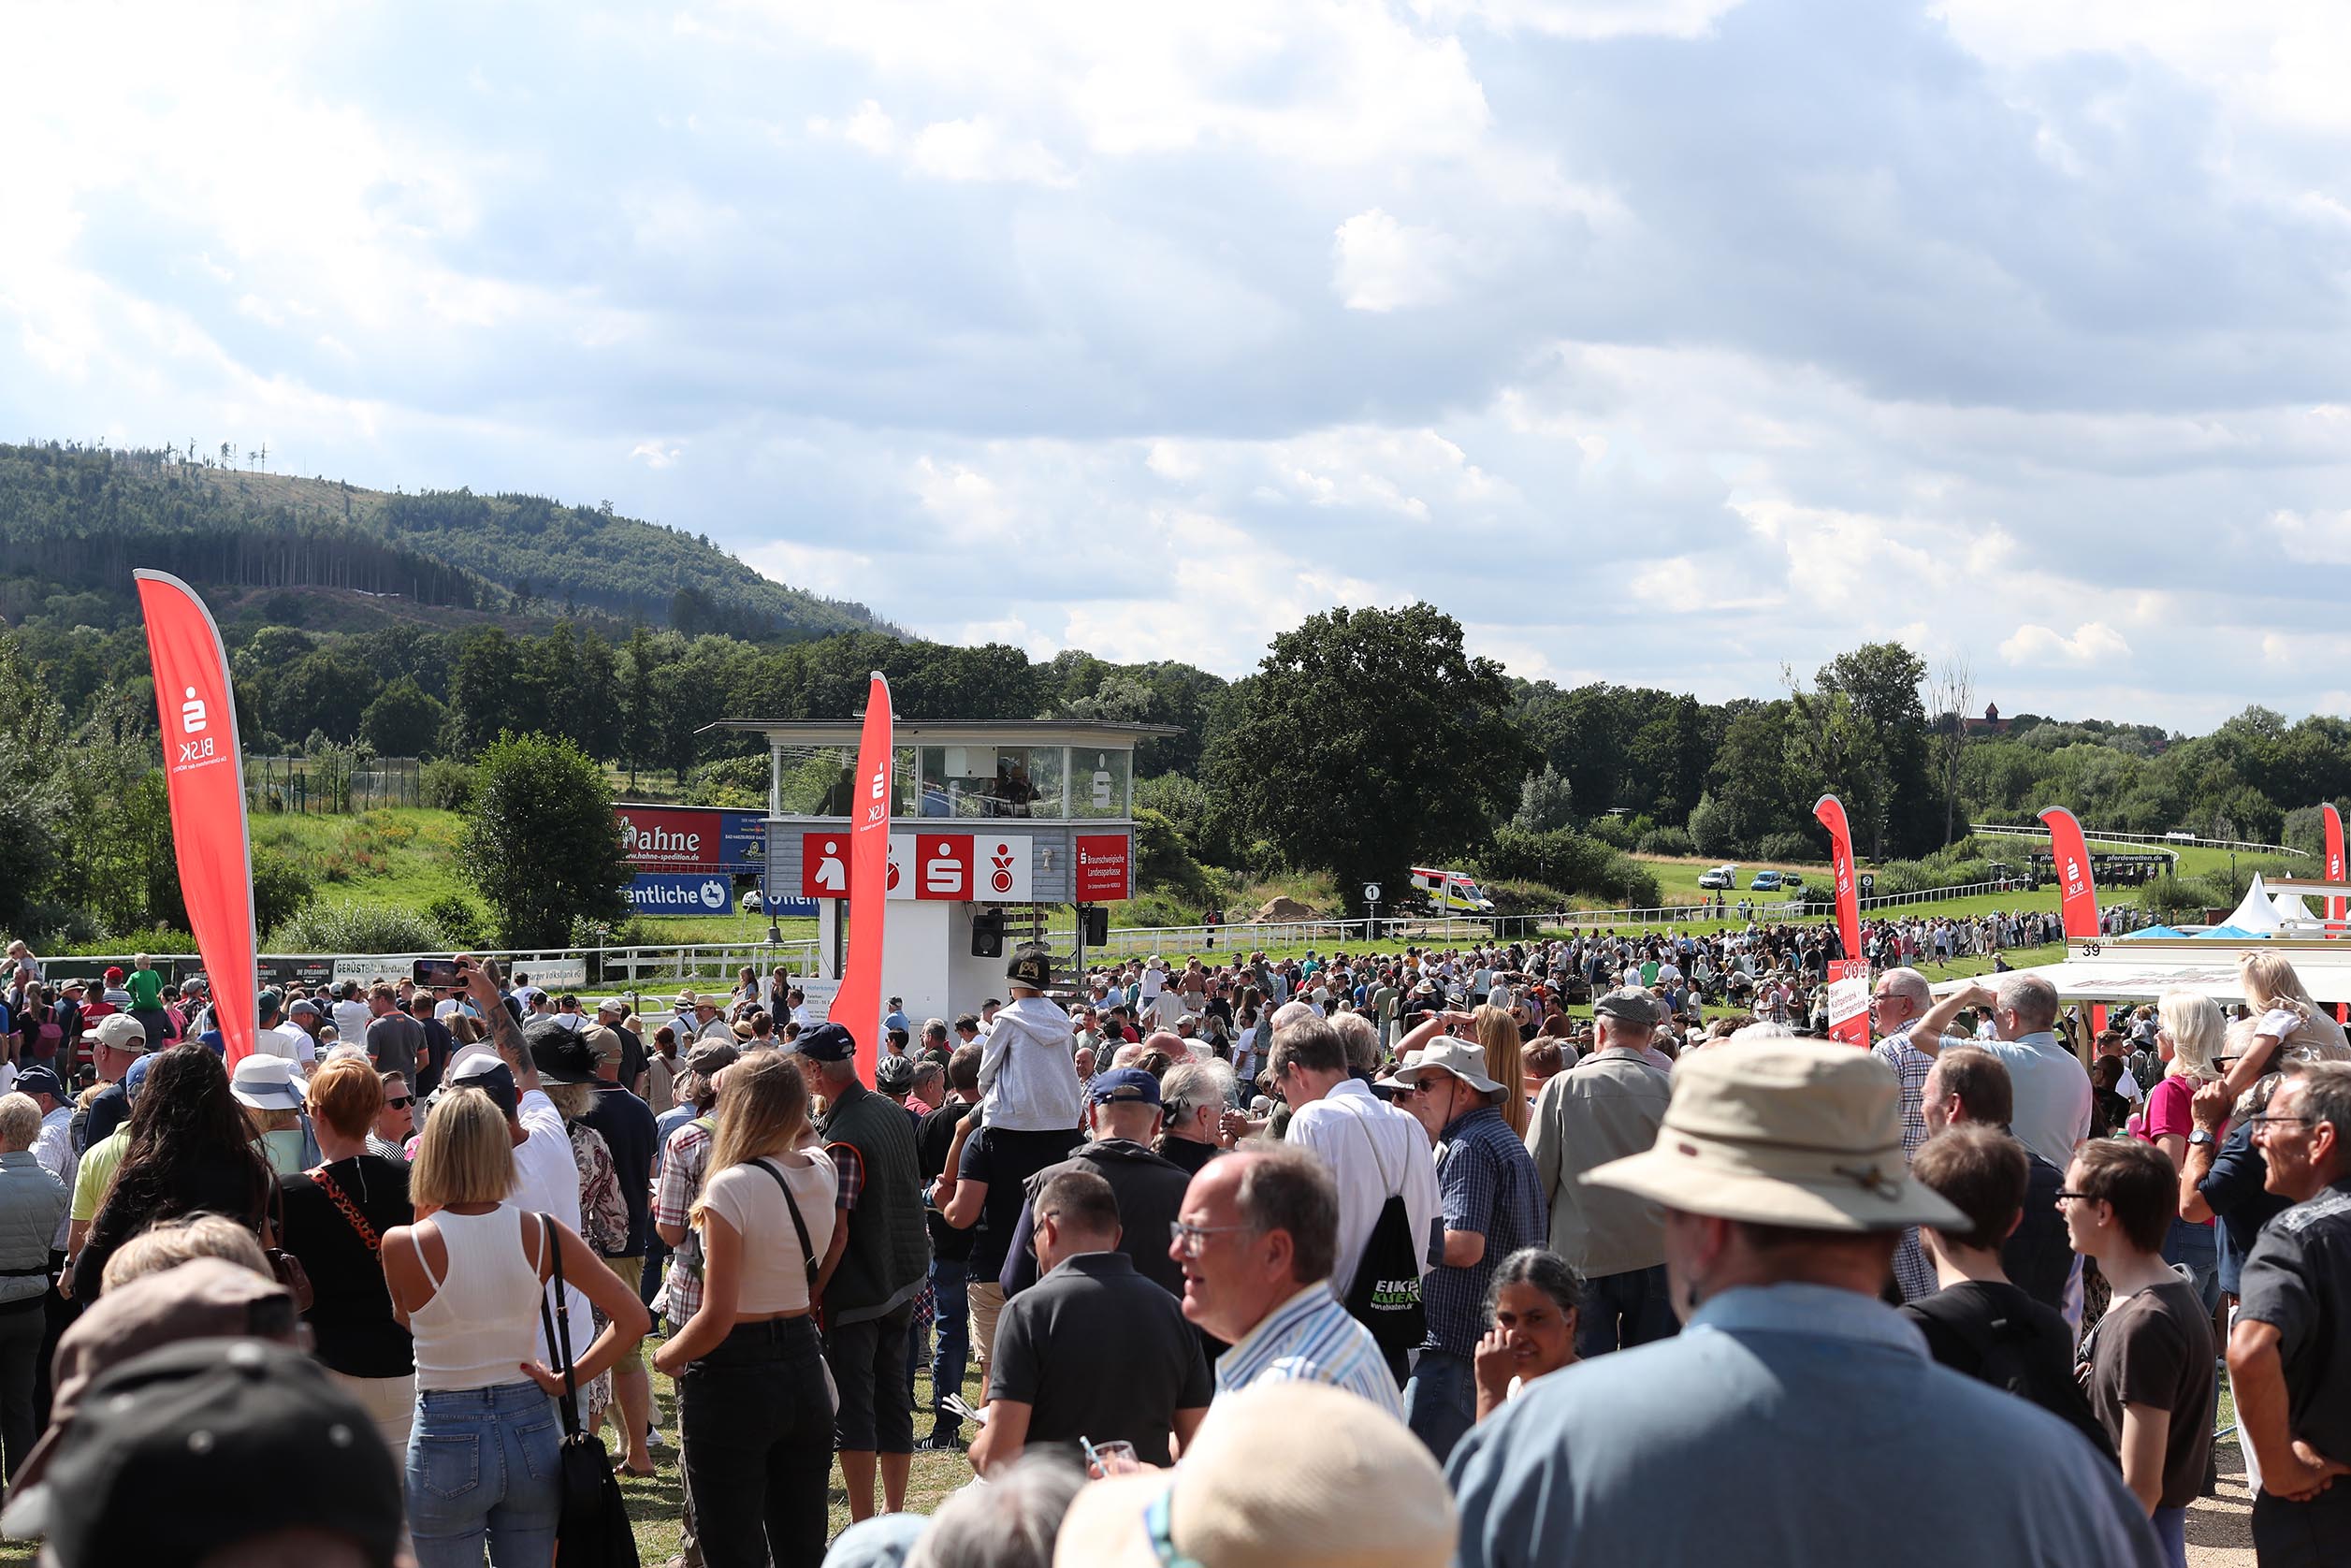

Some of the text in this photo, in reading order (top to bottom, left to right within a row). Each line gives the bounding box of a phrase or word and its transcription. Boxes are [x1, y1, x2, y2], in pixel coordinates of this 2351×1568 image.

[2107, 854, 2163, 863] pferdewetten.de
[1088, 867, 1121, 878] Landessparkasse
[2083, 944, 2100, 957] 39
